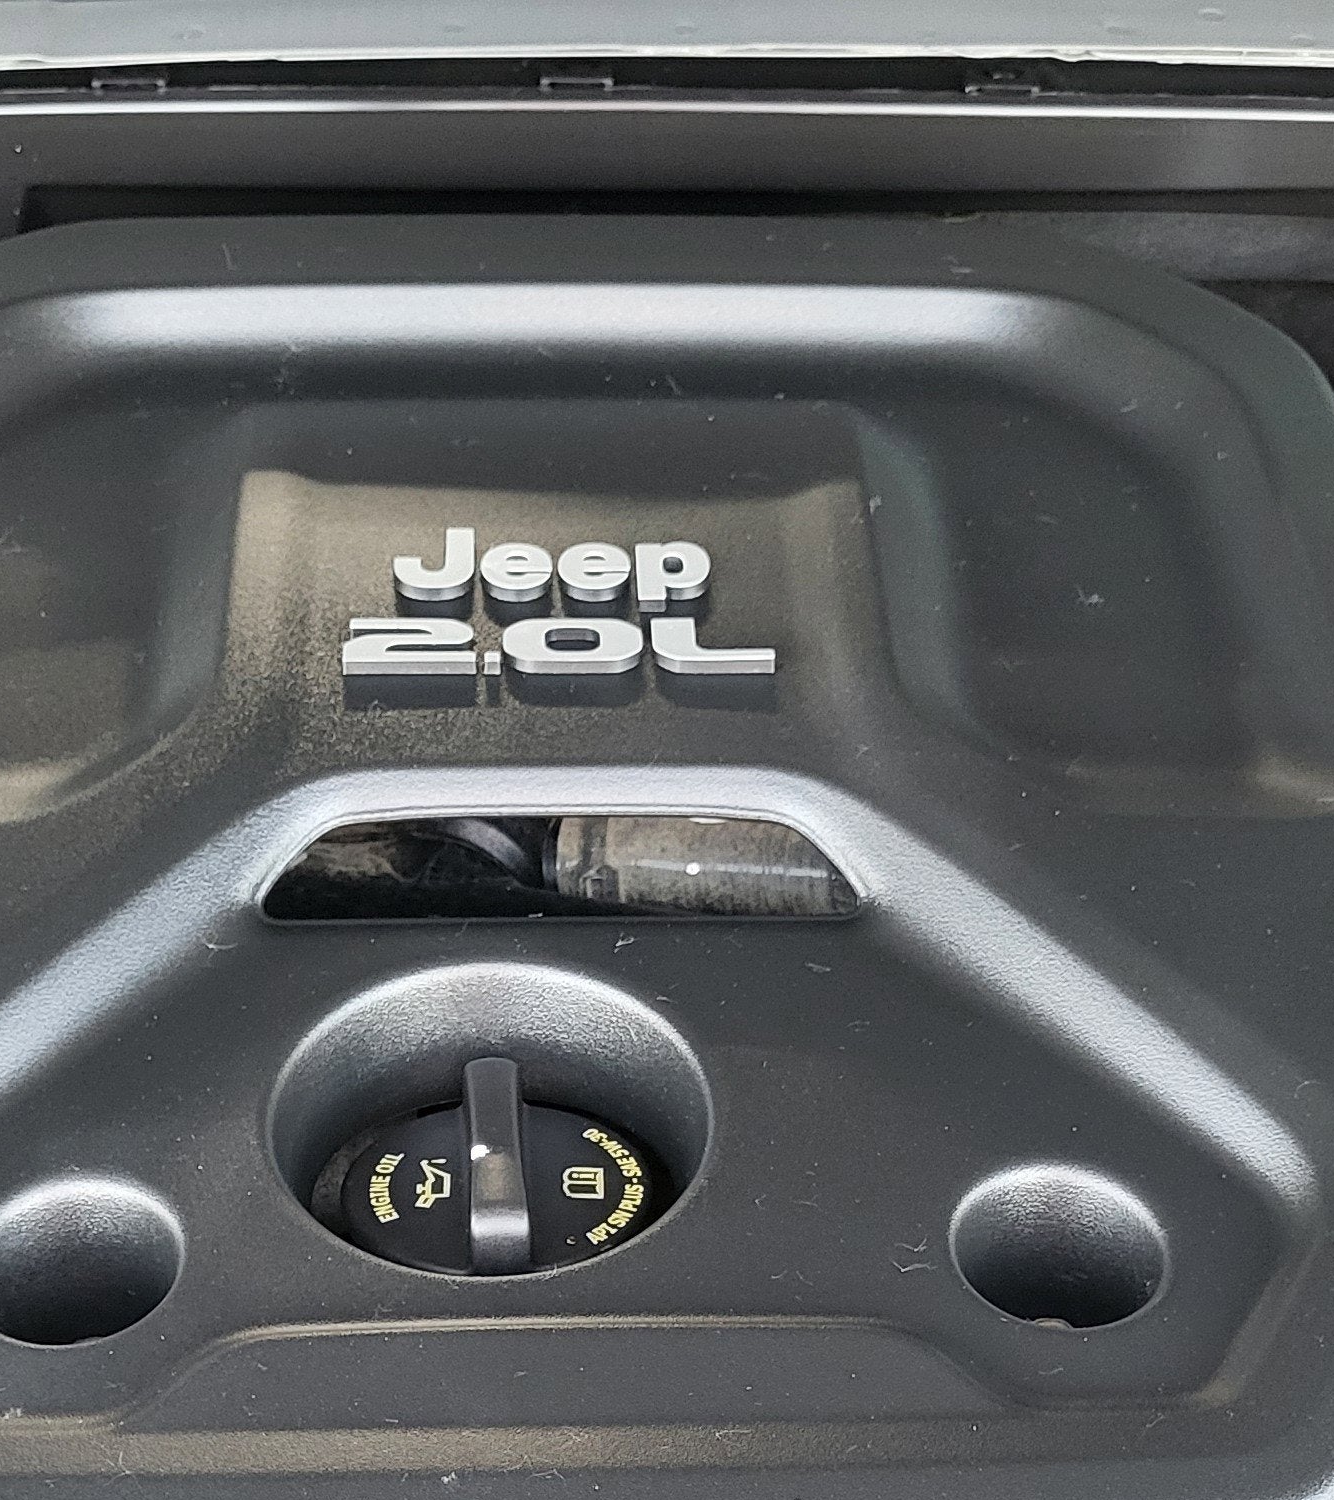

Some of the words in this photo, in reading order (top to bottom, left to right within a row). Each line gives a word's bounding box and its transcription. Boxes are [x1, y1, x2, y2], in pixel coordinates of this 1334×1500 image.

[393, 527, 711, 612] Jeep
[342, 617, 776, 675] 2.0L
[582, 1128, 630, 1158] 5W-30
[375, 1152, 406, 1175] OIL
[616, 1156, 642, 1177] SAE
[369, 1174, 400, 1223] ENGINE
[618, 1183, 645, 1212] PLUS
[607, 1209, 634, 1228] SN
[585, 1222, 618, 1245] API
